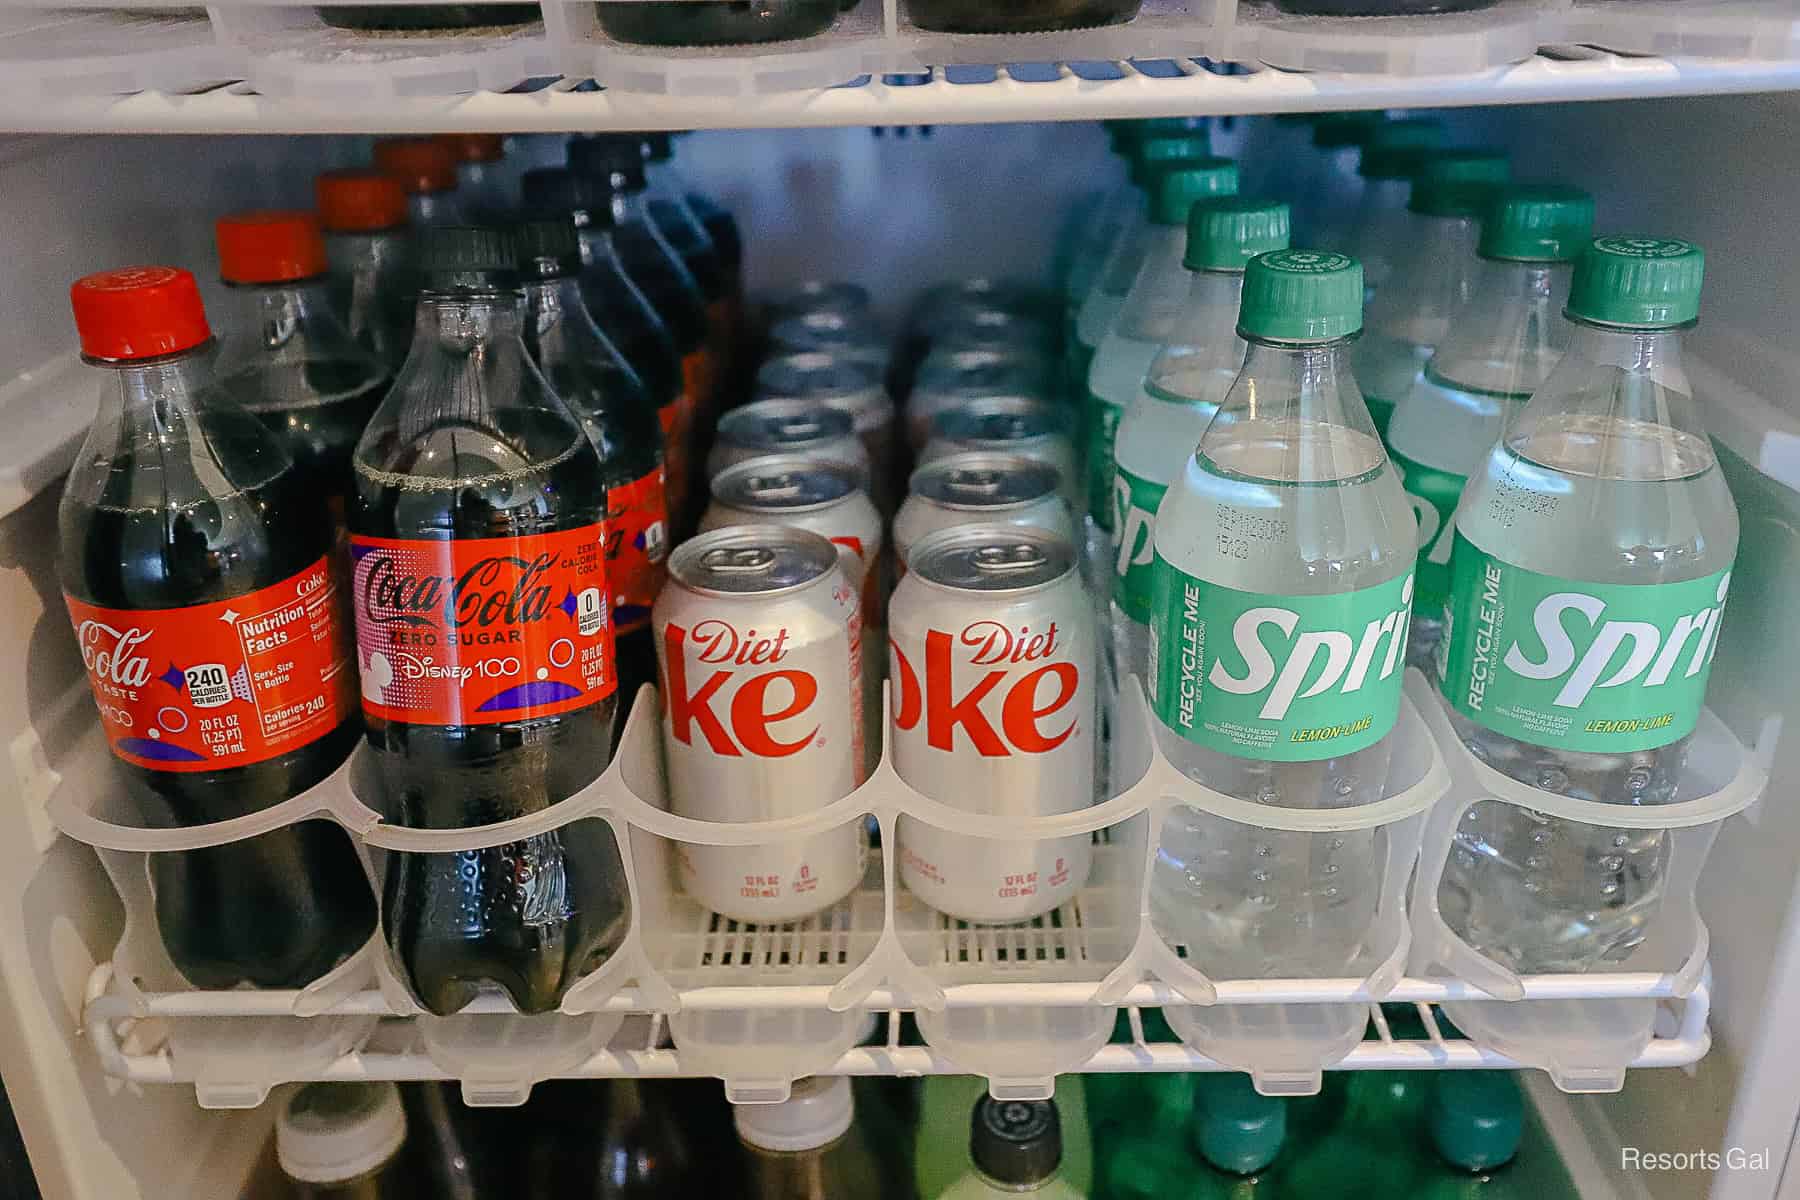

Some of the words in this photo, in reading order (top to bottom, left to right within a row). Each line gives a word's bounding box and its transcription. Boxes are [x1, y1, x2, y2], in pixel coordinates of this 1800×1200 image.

[585, 593, 593, 612] 0
[1183, 583, 1200, 622] ME
[242, 605, 305, 639] Nutrition
[246, 631, 288, 654] Facts
[390, 632, 436, 646] ZERO
[447, 630, 521, 646] SUGAR
[691, 620, 789, 665] Diet
[960, 621, 1059, 665] Diet
[1469, 605, 1496, 711] RECYCLE
[1483, 564, 1502, 604] ME
[187, 667, 224, 689] 240
[475, 657, 520, 677] 100
[1180, 625, 1198, 728] RECYCLE
[190, 685, 228, 698] CALORIES
[264, 703, 305, 724] Calories
[305, 695, 325, 715] 240
[200, 719, 211, 731] 20
[213, 717, 225, 729] FL
[1290, 714, 1373, 742] LEMON-LIME
[1584, 713, 1672, 733] LEMON-LIME
[212, 744, 229, 757] 591
